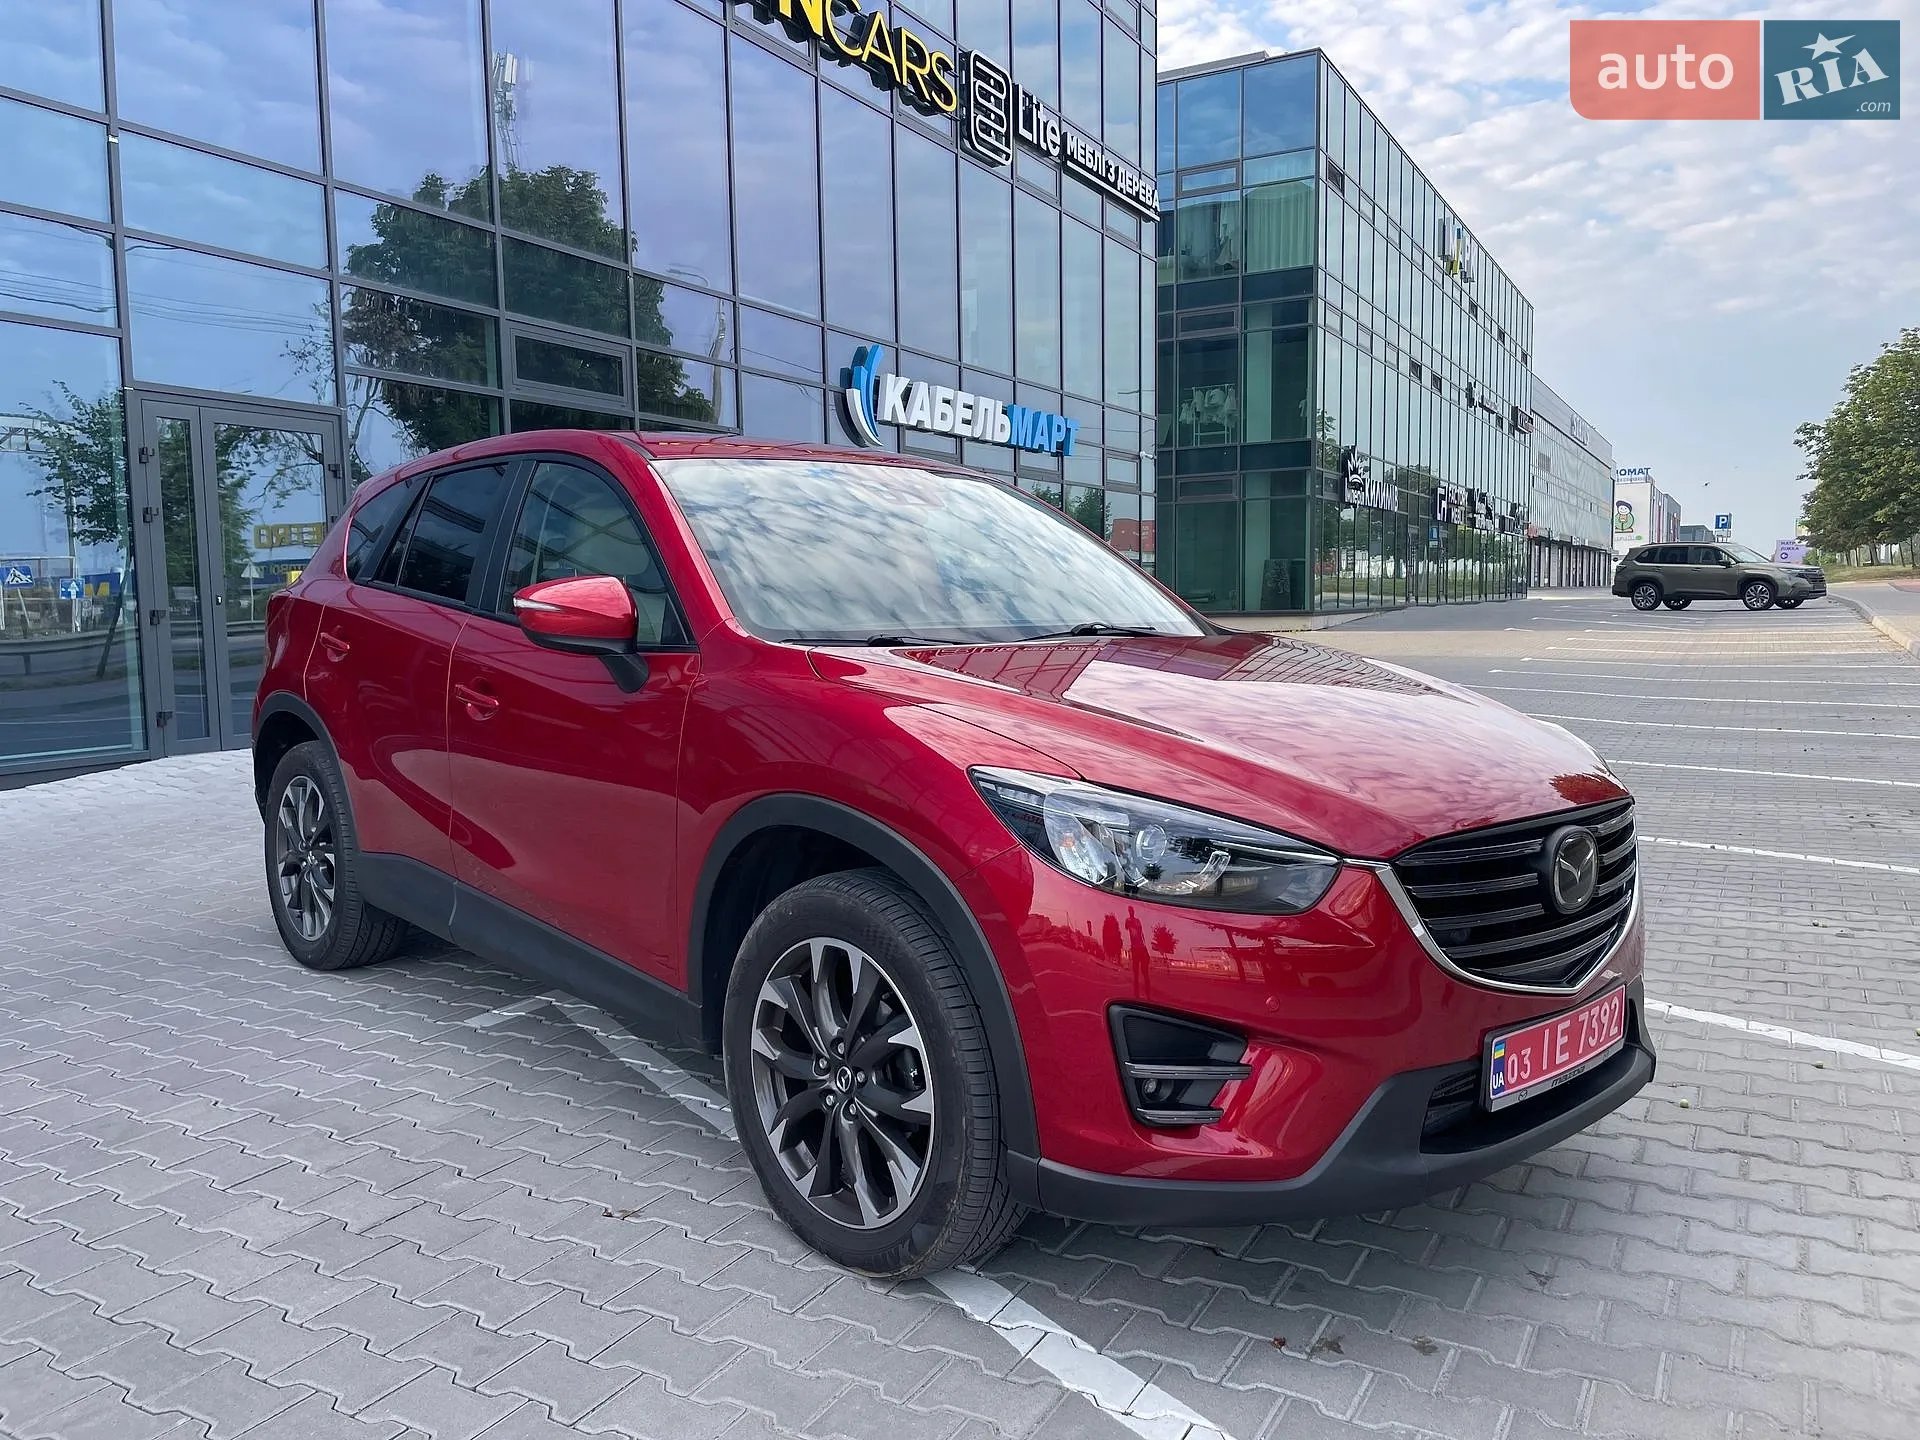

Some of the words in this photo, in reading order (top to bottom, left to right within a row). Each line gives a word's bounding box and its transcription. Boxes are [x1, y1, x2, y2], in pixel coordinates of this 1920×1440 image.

[1017, 89, 1061, 158] Lite
[1066, 132, 1106, 178] МЕБЛІ
[1107, 160, 1116, 183] З
[1117, 166, 1161, 212] ДЕРЕВА
[877, 373, 1081, 457] КАБЕЛЬМАРТ
[1719, 516, 1729, 528] P
[1492, 1072, 1505, 1089] UA
[1507, 1047, 1532, 1085] 03
[1542, 1020, 1571, 1071] IE
[1578, 996, 1619, 1055] 7392
